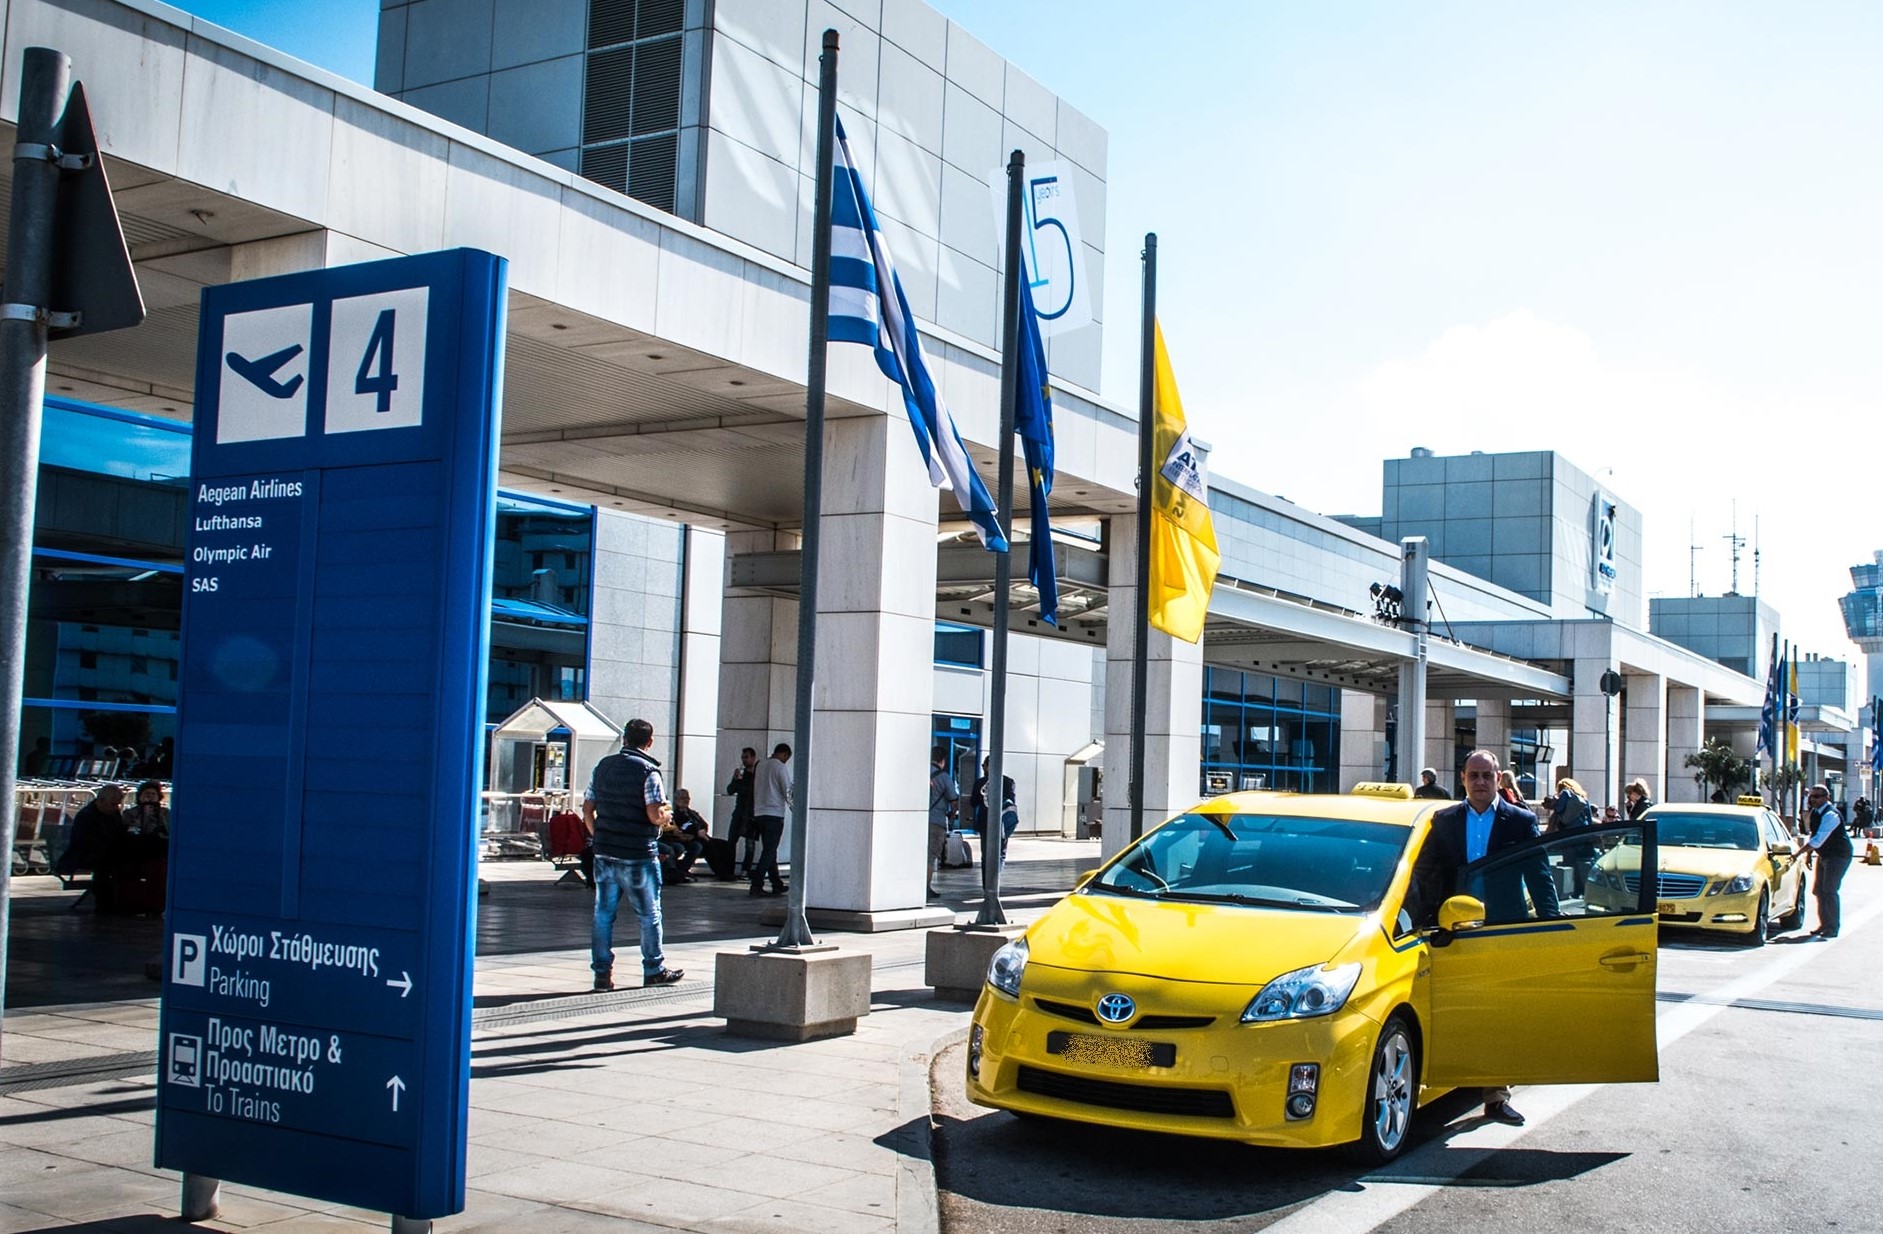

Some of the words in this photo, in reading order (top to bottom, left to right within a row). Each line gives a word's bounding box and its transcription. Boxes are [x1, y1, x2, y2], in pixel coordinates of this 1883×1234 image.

[355, 308, 398, 413] 4
[198, 484, 247, 506] Aegean
[250, 479, 303, 499] Airlines
[195, 515, 262, 531] Lufthansa
[193, 545, 248, 565] Olympic
[251, 543, 272, 559] Air
[192, 577, 219, 592] SAS
[179, 938, 199, 979] P
[211, 924, 264, 961] Χώροι
[269, 931, 380, 977] Στάθμευσης
[209, 967, 270, 1008] Parking
[208, 1017, 253, 1057] Προς
[260, 1025, 320, 1065] Μετρο
[327, 1035, 342, 1064] &
[206, 1050, 314, 1094] Προαστιακό
[205, 1083, 223, 1113] To
[229, 1087, 280, 1123] Trains
